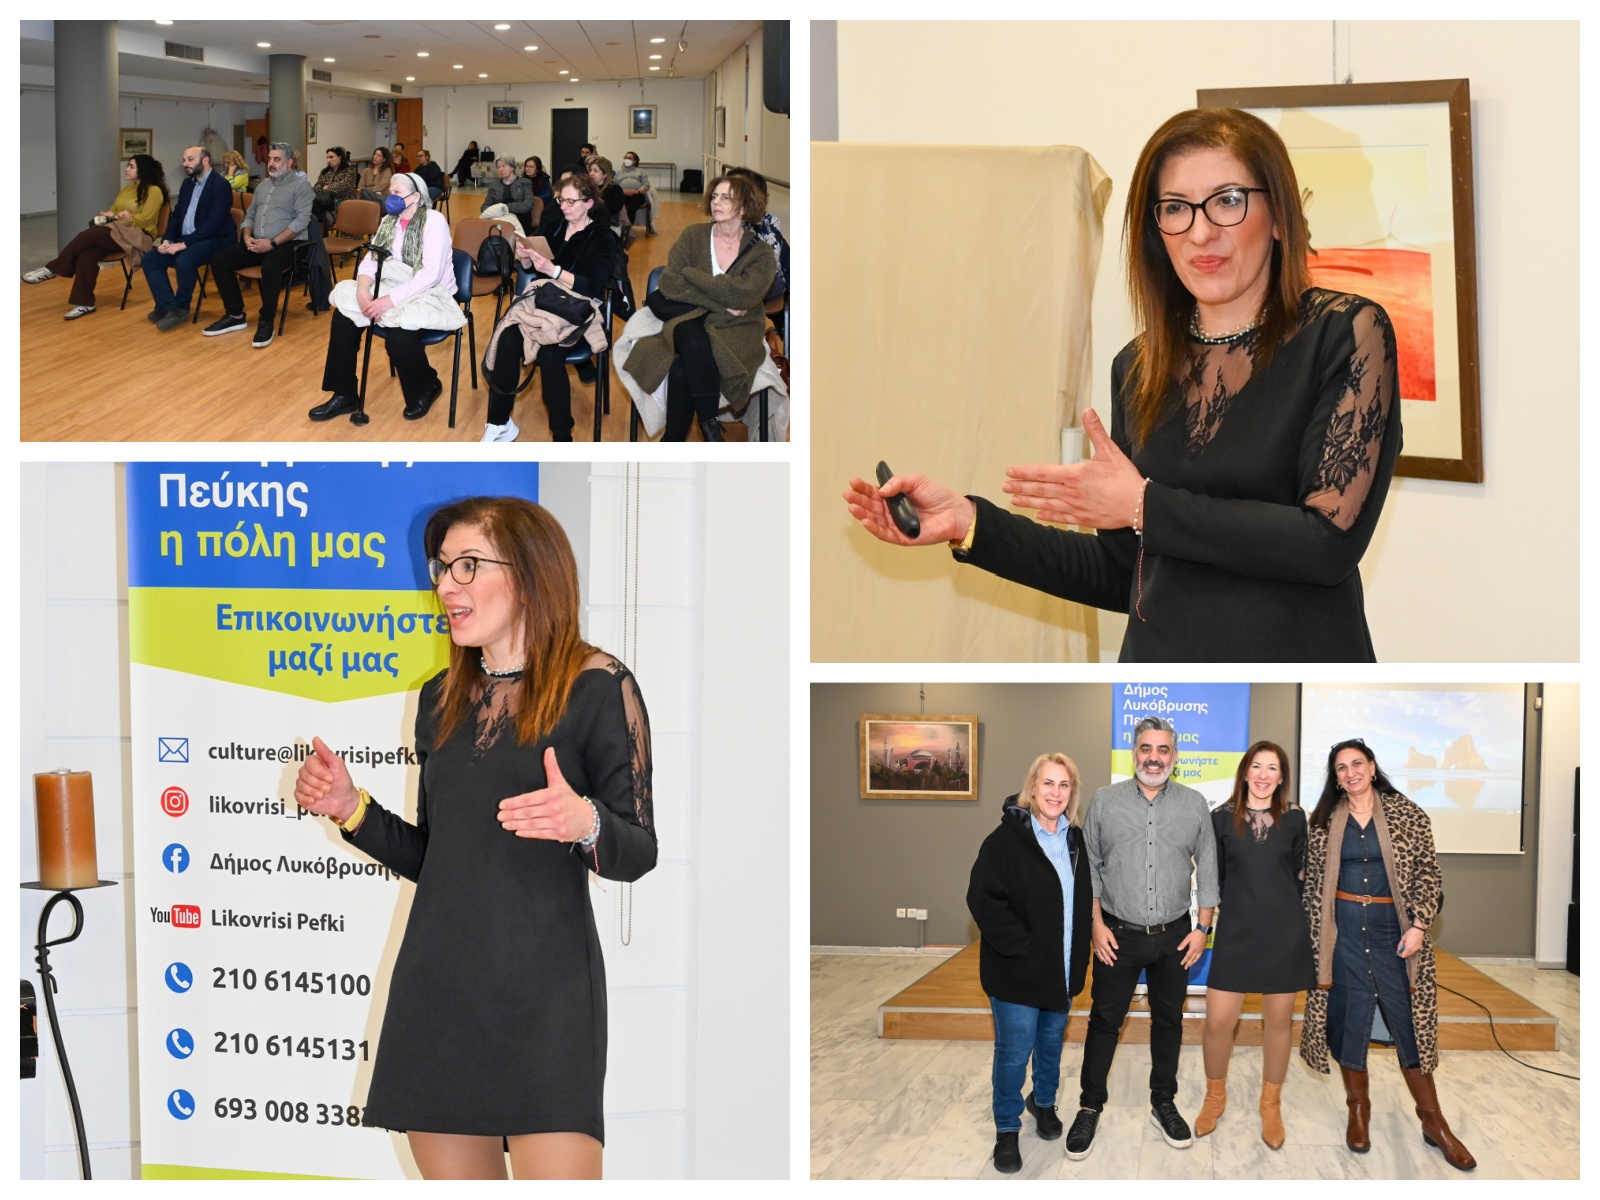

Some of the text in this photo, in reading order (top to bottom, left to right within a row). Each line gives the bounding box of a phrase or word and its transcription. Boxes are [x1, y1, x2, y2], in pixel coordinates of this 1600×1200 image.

[160, 471, 309, 518] Πεύκης
[160, 520, 386, 568] η πόλη μας
[217, 604, 450, 640] Επικοινωνήστε
[269, 643, 399, 679] μαζί μας
[1124, 683, 1169, 699] Δήμος
[1123, 699, 1208, 715] Λυκόβρυσης
[1183, 768, 1202, 779] μας
[210, 853, 272, 875] Δήμος
[150, 906, 345, 932] YouTube Likovrisi Pefki
[213, 967, 371, 996] 210 6145100
[214, 1031, 370, 1062] 210 6145131
[215, 1098, 375, 1128] 693 008 338
